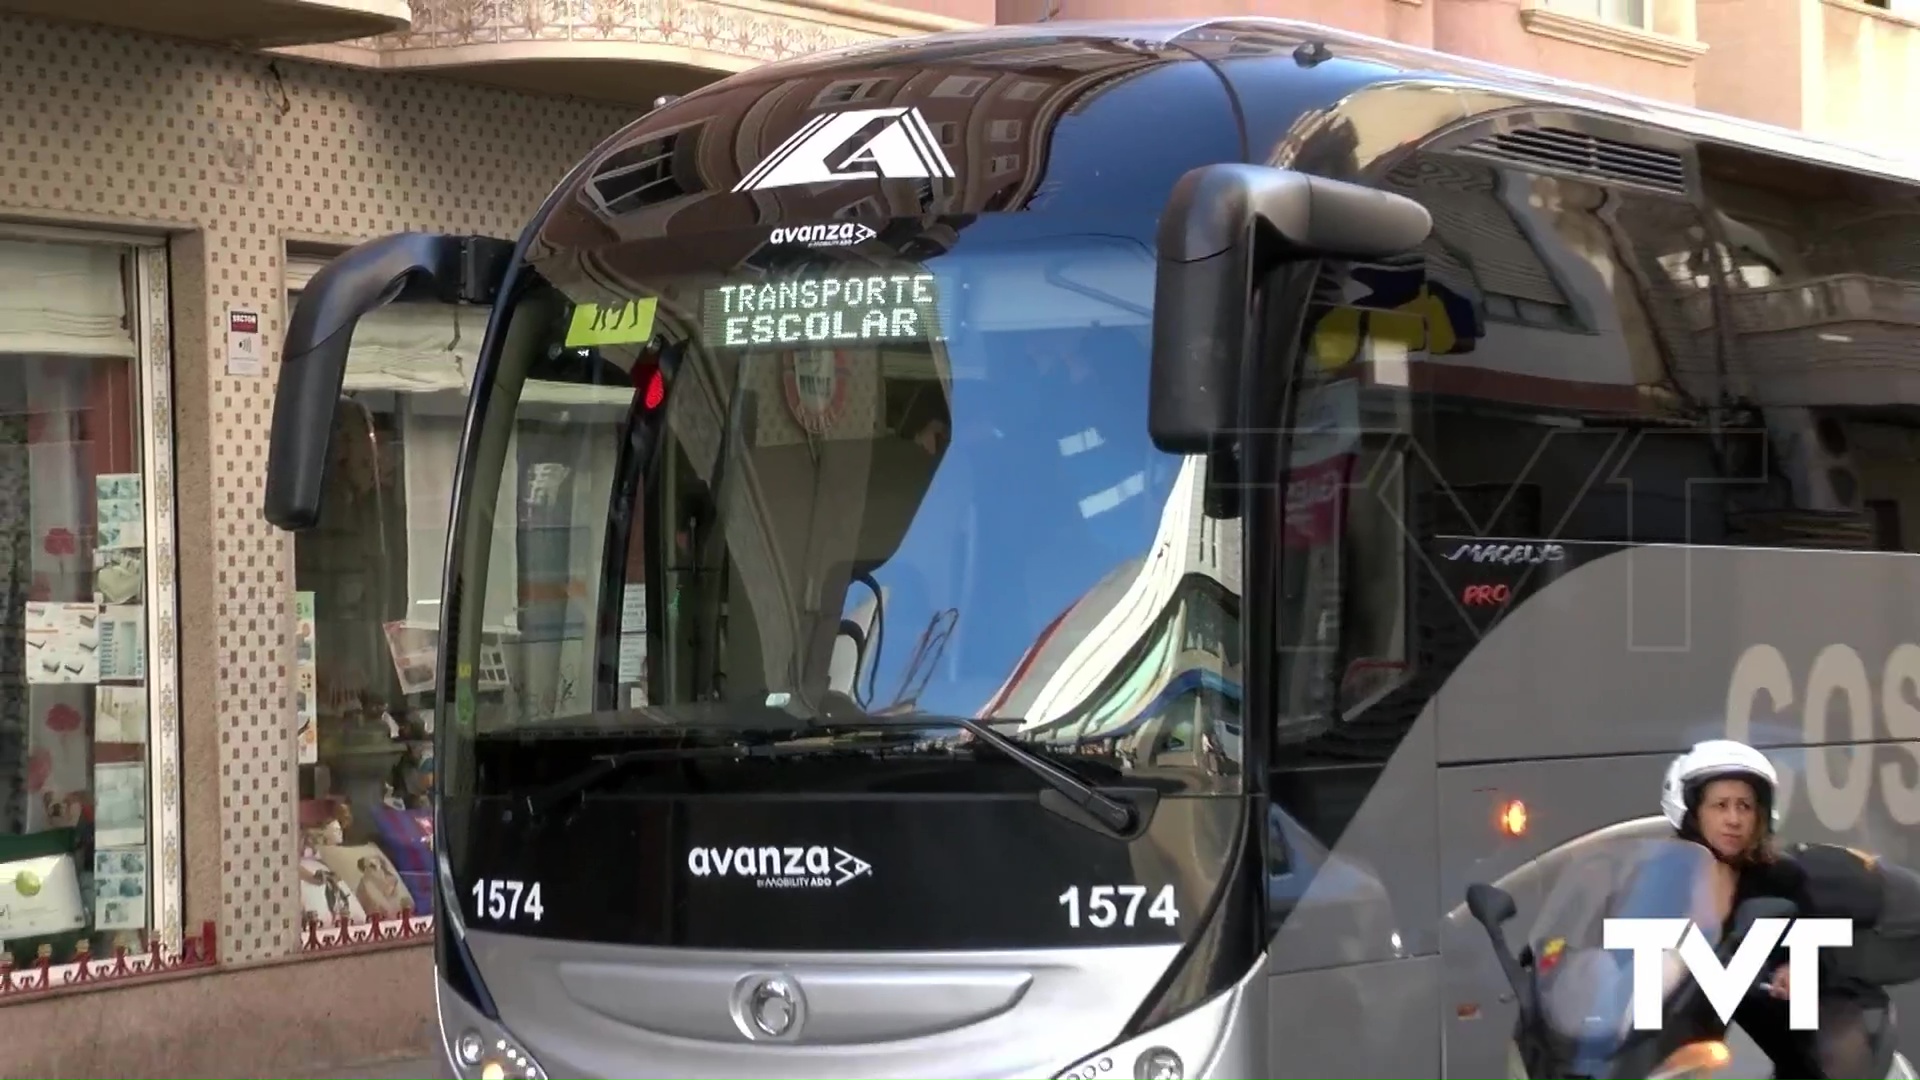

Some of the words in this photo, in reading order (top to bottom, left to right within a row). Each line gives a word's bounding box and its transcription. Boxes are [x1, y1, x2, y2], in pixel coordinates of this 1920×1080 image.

[770, 223, 854, 244] avanza
[719, 275, 933, 312] TRANSPORTE
[725, 308, 918, 344] ESCOLAR
[1463, 584, 1511, 606] PRO
[688, 845, 831, 876] avanza
[765, 877, 809, 888] MOBILITY
[810, 877, 832, 888] ADO
[472, 878, 544, 921] 1574
[1059, 884, 1180, 928] 1574
